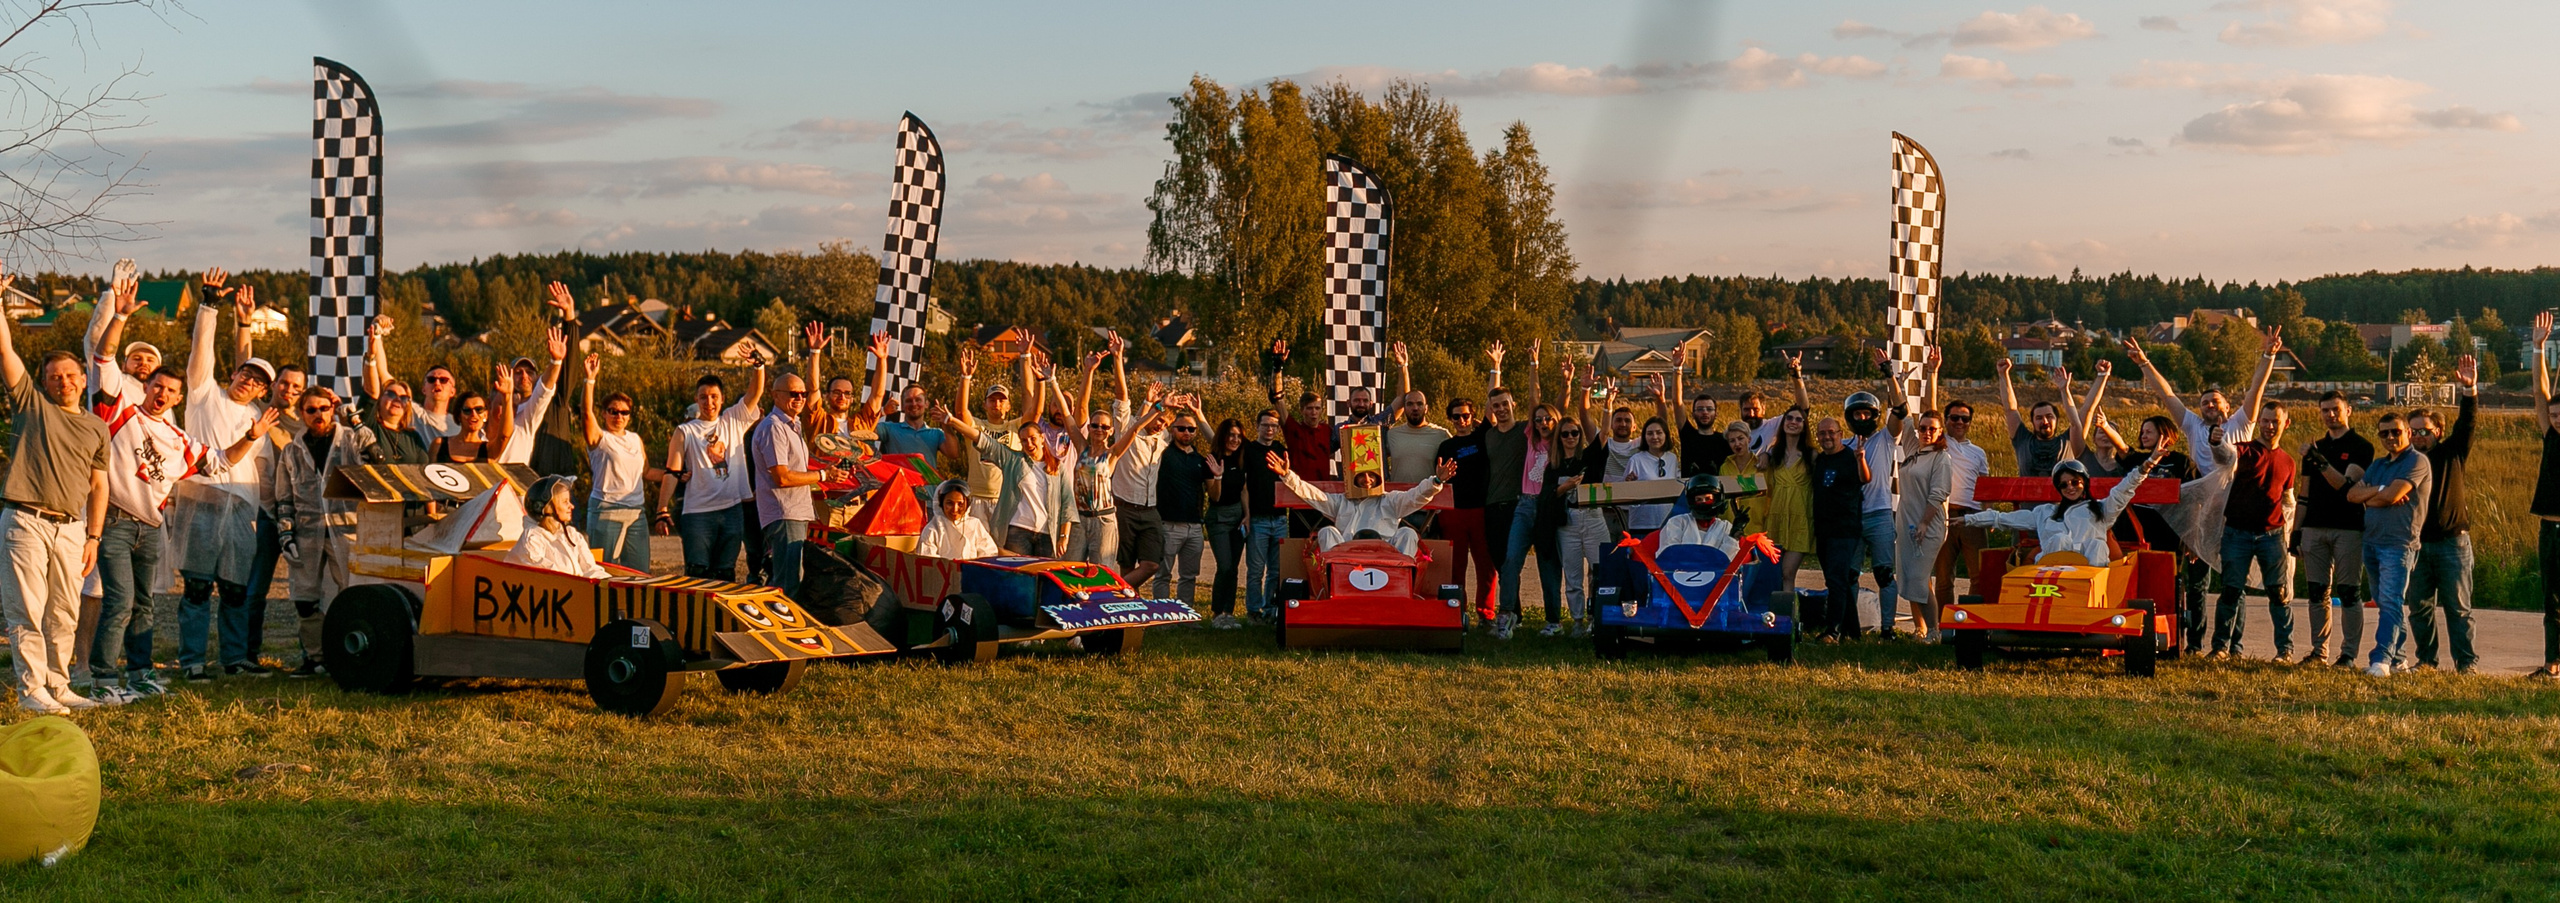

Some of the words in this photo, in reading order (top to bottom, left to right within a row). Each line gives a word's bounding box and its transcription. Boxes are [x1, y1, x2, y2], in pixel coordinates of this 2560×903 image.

[435, 469, 459, 487] 5
[1363, 571, 1374, 586] 1
[1685, 571, 1703, 582] 2
[473, 575, 573, 631] ВЖИК
